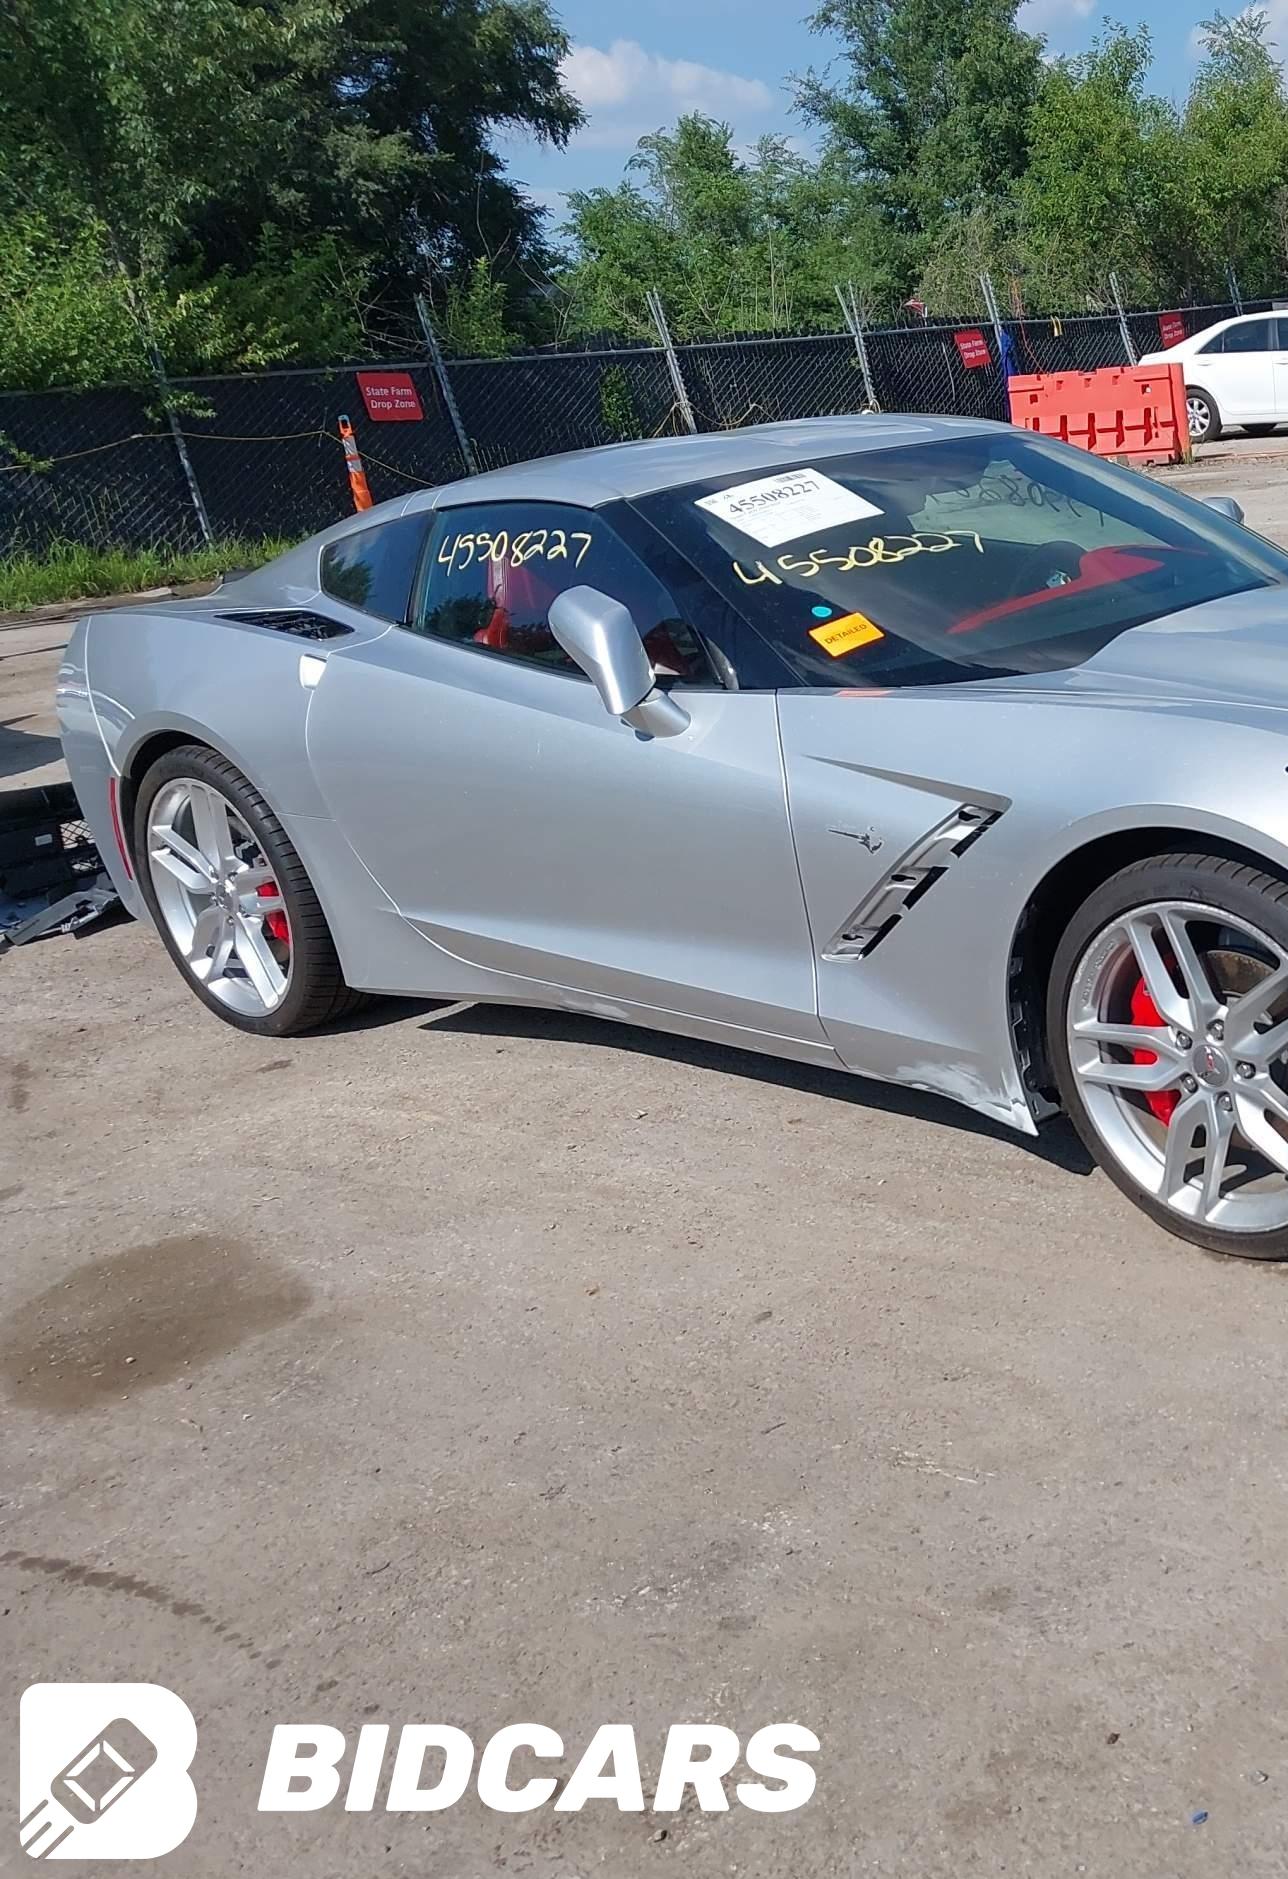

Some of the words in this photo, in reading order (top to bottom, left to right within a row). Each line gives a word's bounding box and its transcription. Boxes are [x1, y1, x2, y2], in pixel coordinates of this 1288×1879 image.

[366, 387, 389, 396] State
[391, 387, 412, 396] Farm
[371, 400, 392, 410] Drop
[394, 400, 416, 408] Zone
[729, 480, 820, 514] 45508227
[437, 529, 592, 577] 45508227
[733, 530, 984, 584] 45508227
[824, 624, 867, 644] DETAILED
